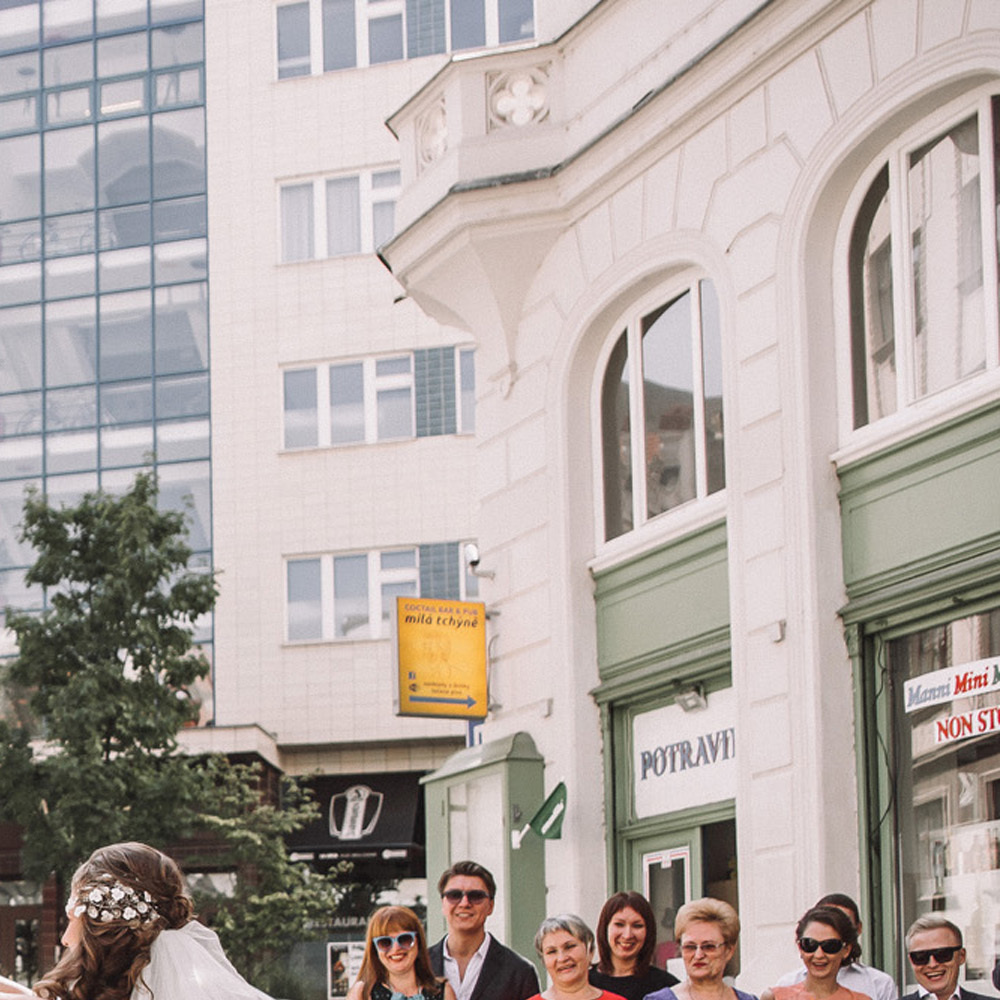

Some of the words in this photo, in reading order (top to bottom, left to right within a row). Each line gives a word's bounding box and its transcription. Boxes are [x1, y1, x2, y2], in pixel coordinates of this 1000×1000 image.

[405, 612, 432, 624] milá
[907, 678, 951, 707] Manni
[953, 667, 989, 696] Mini
[937, 713, 973, 742] NON
